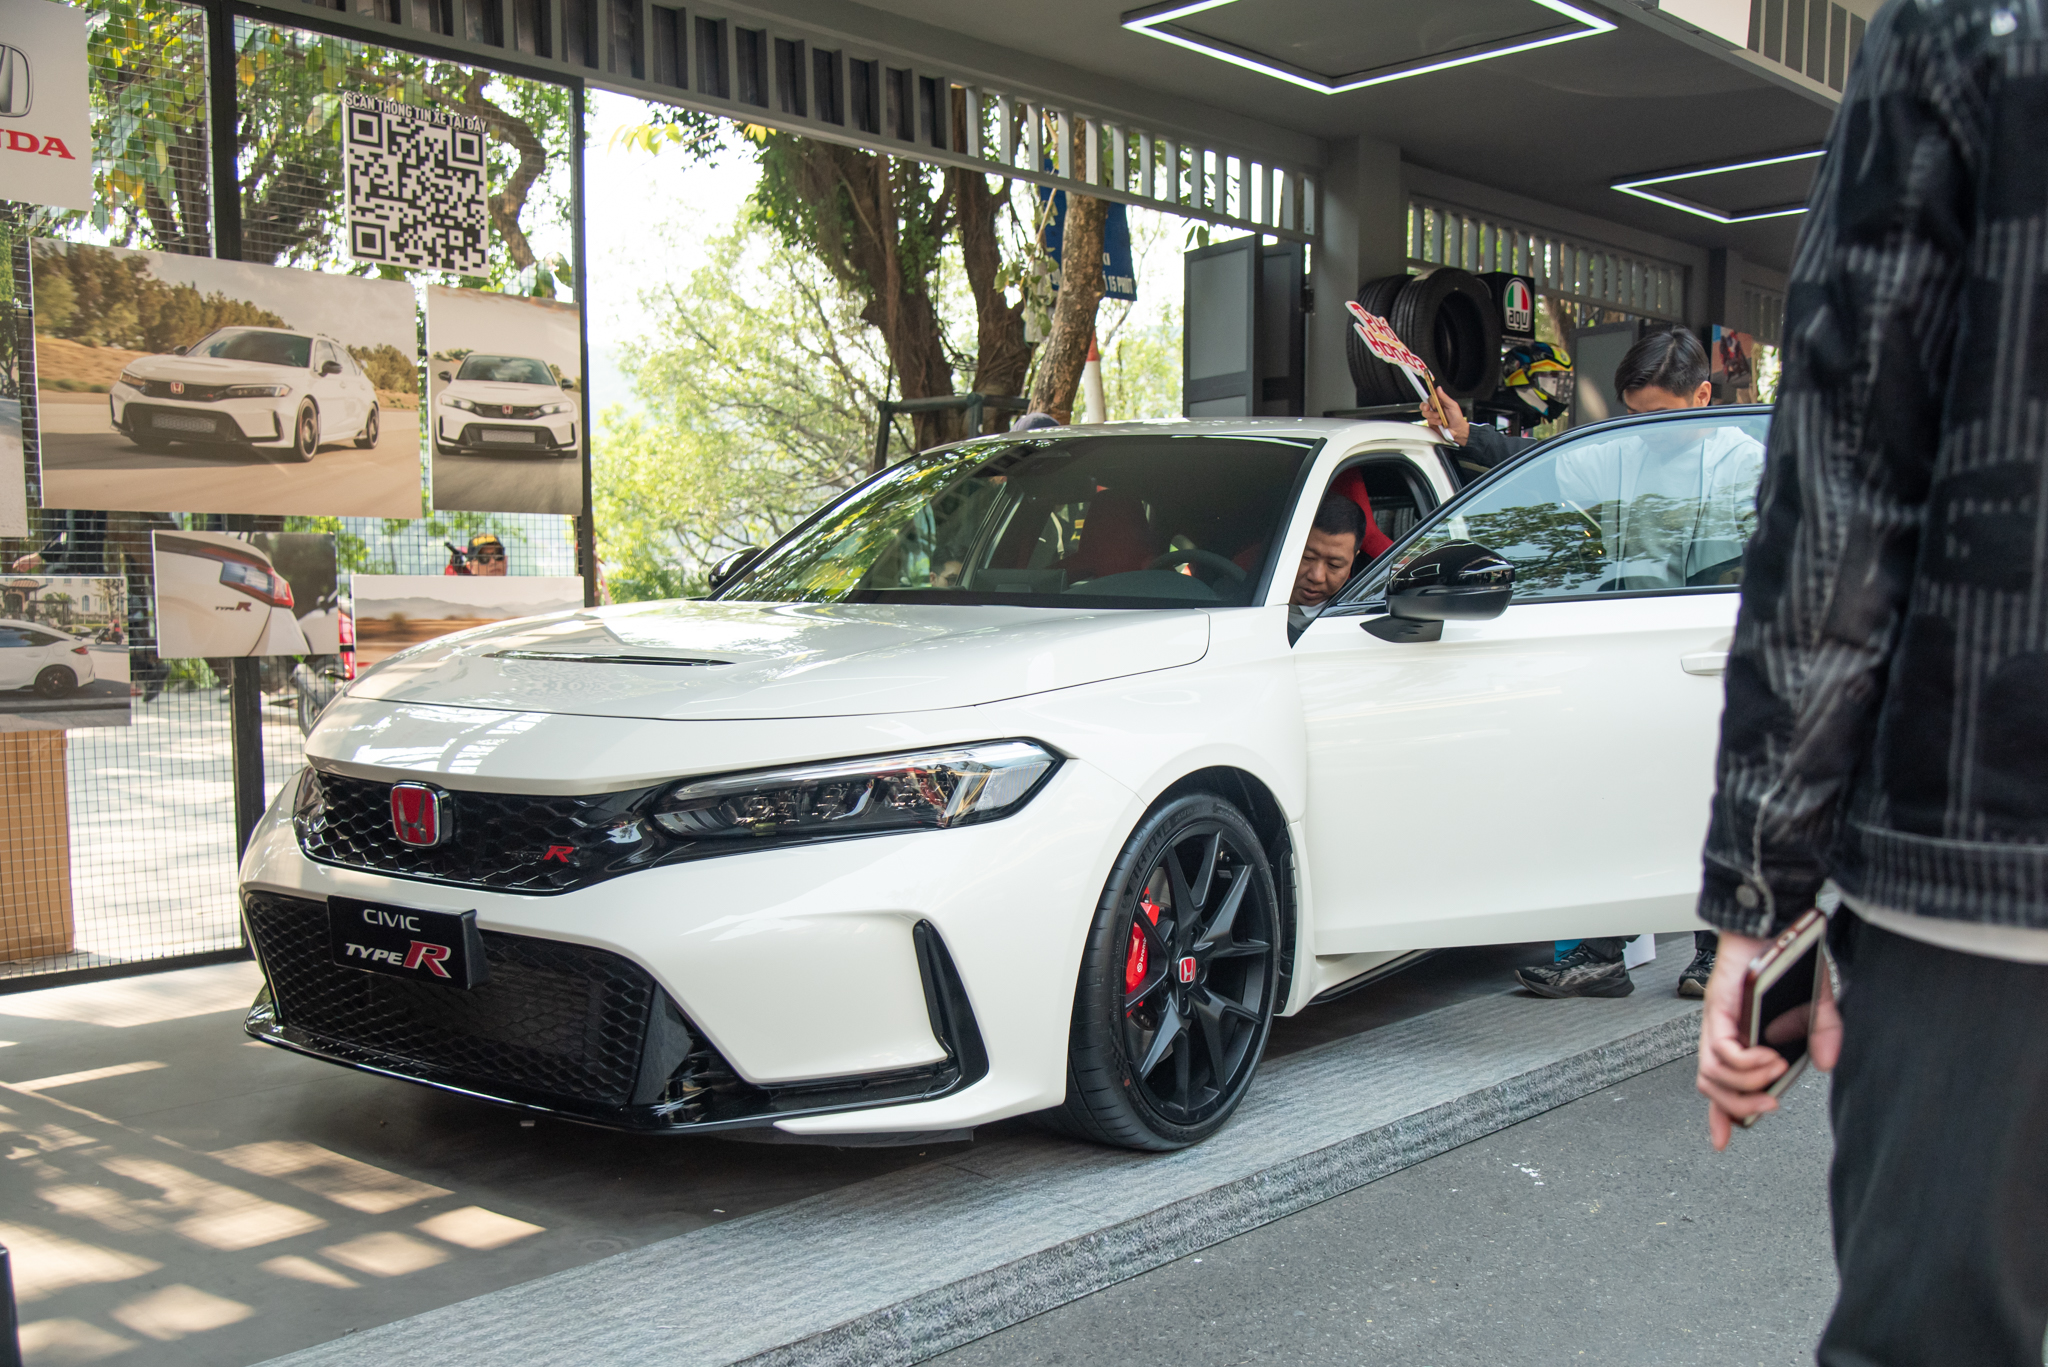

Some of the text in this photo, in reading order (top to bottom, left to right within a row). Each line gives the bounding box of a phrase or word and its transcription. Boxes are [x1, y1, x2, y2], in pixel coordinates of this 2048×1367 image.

[346, 92, 375, 110] SCAN
[414, 106, 432, 123] TIN
[433, 111, 447, 125] XE
[0, 128, 76, 160] DA
[1108, 275, 1117, 293] 15
[363, 908, 421, 932] CIVIC
[345, 940, 452, 979] TYPE R
[1139, 937, 1147, 962] bremb
